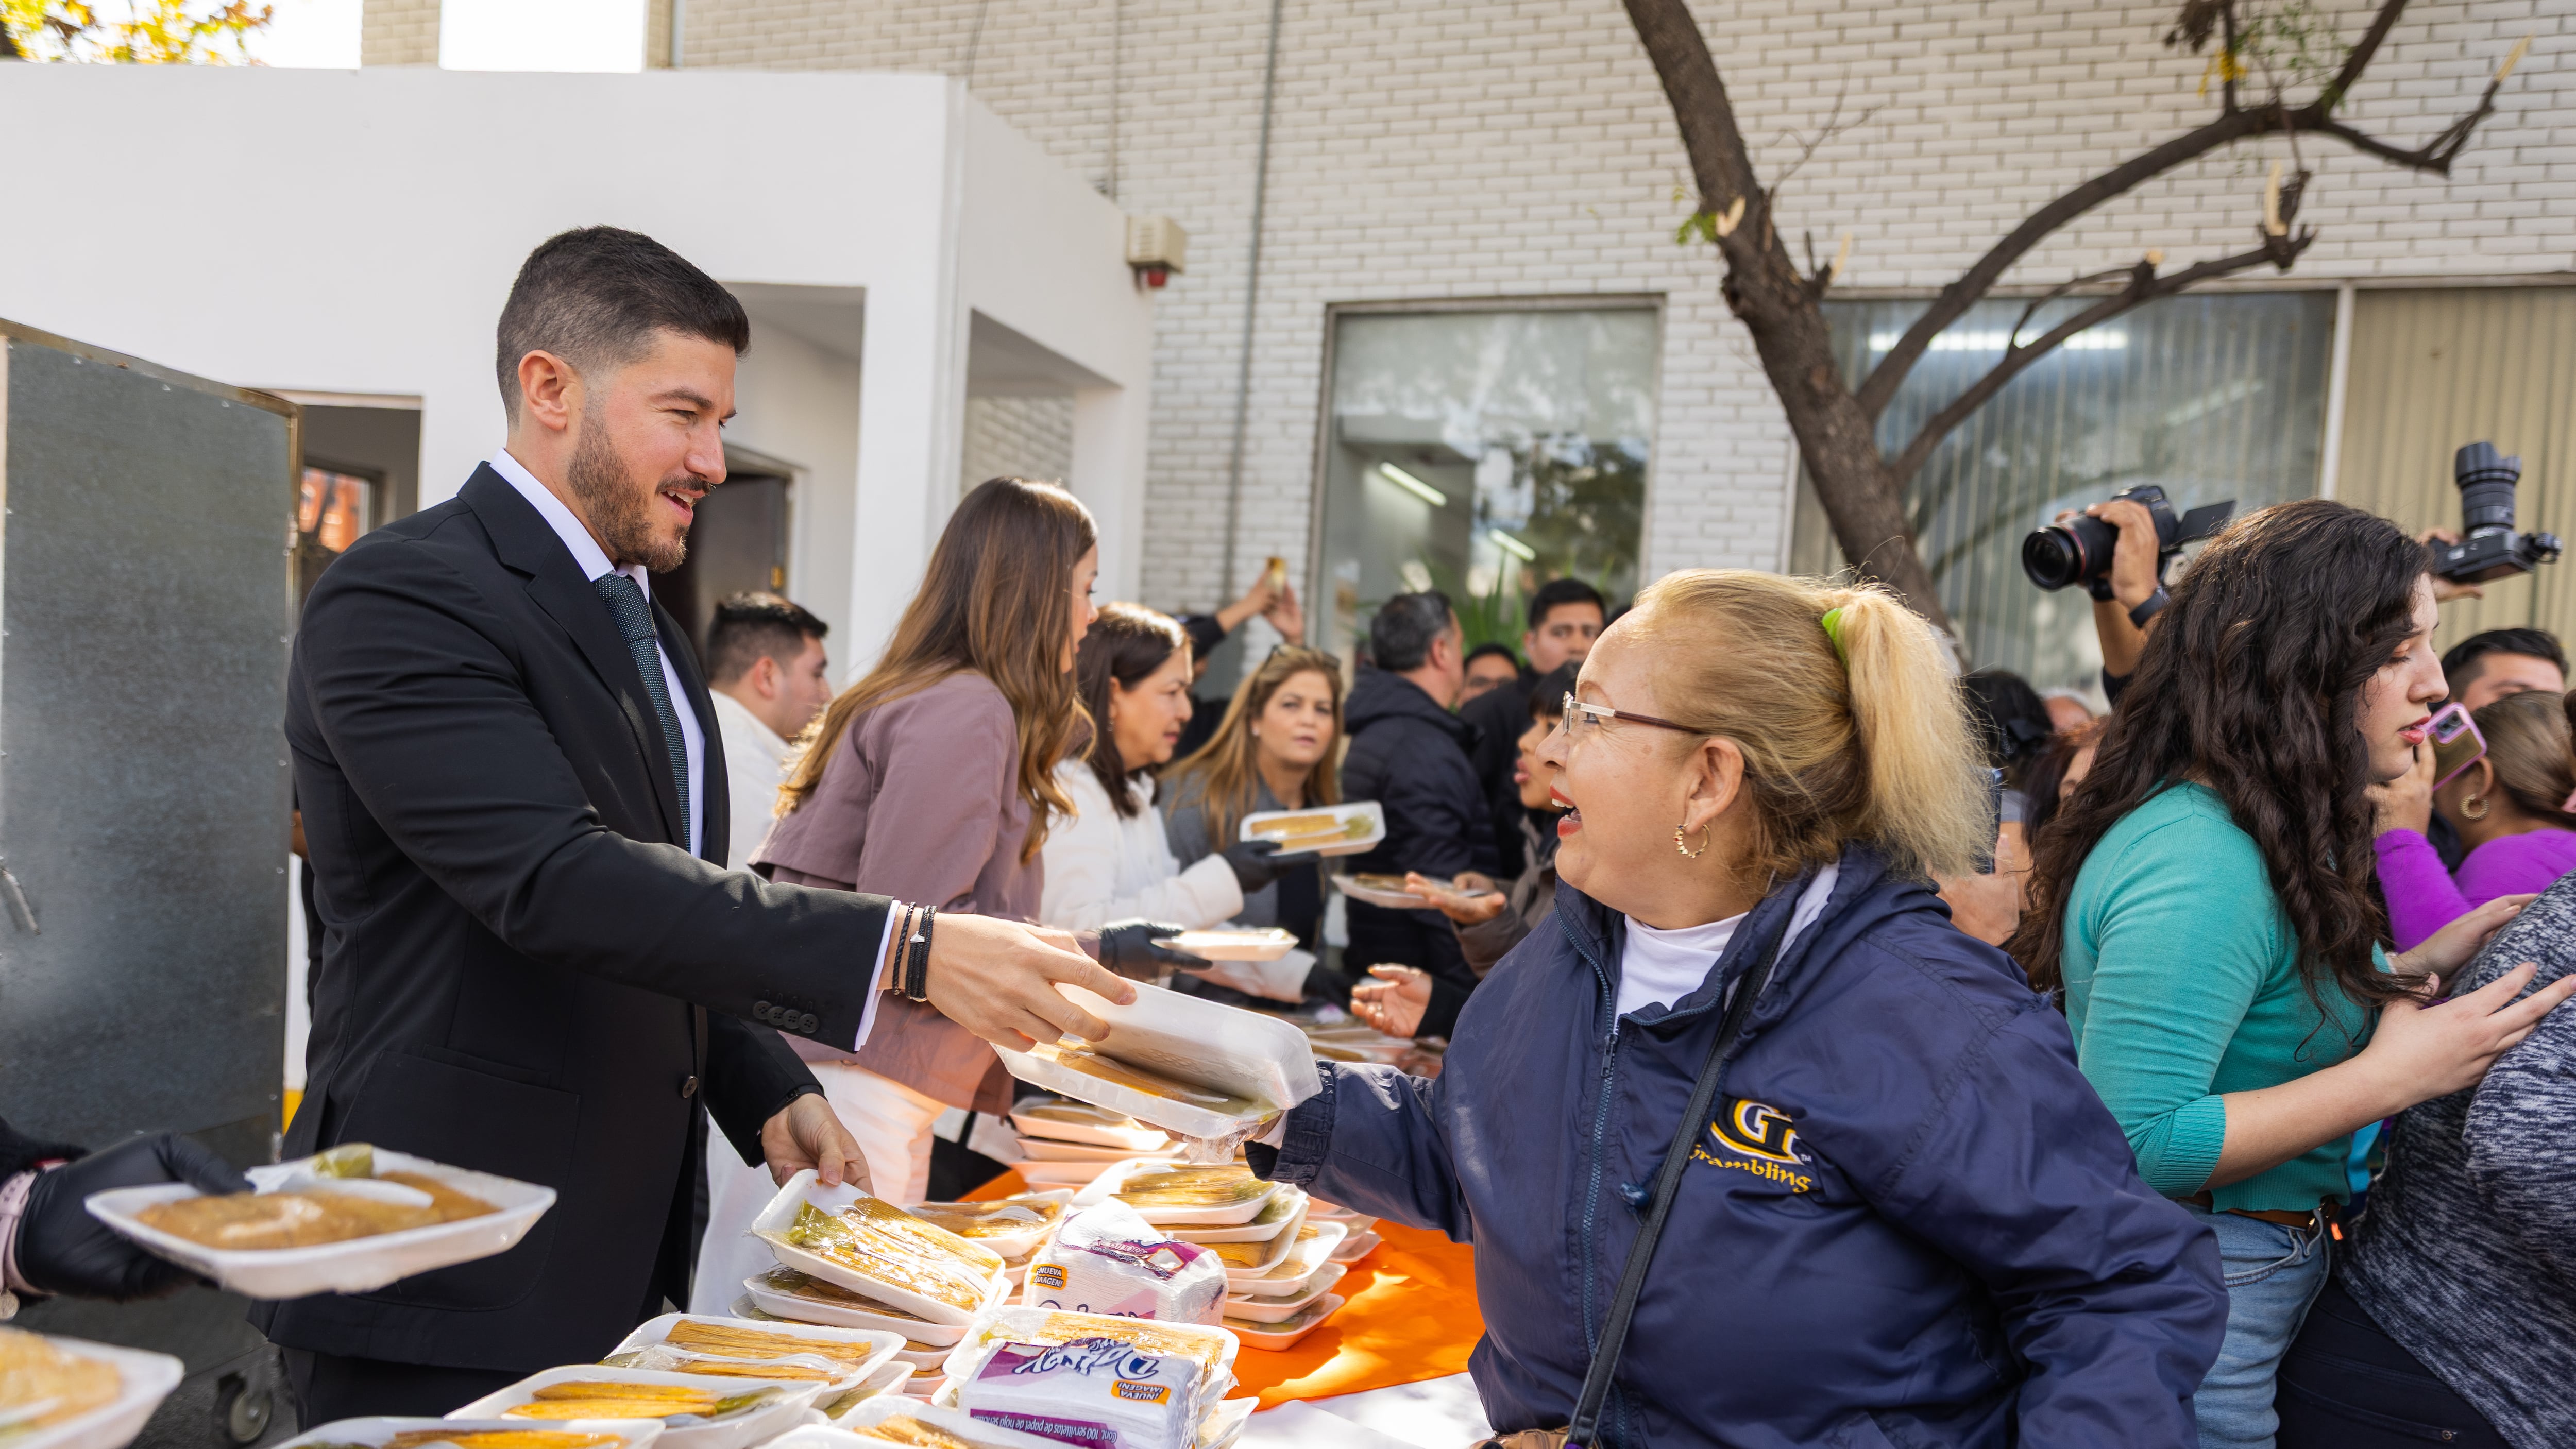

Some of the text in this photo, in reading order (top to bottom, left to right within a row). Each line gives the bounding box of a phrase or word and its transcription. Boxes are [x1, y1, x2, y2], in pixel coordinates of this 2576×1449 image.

[1689, 1144, 1812, 1193] rambling
[1033, 1276, 1063, 1287] IMAGEN!
[1117, 1382, 1164, 1393] IMAGEN!
[1120, 1390, 1160, 1401] ¡NUEVA
[999, 1415, 1015, 1430] hoja
[1015, 1420, 1024, 1430] de
[1025, 1418, 1044, 1431] papel
[1043, 1423, 1053, 1435] de
[1054, 1424, 1087, 1438] servilletas
[1086, 1428, 1098, 1441] 100
[1101, 1430, 1117, 1443] Cont.
